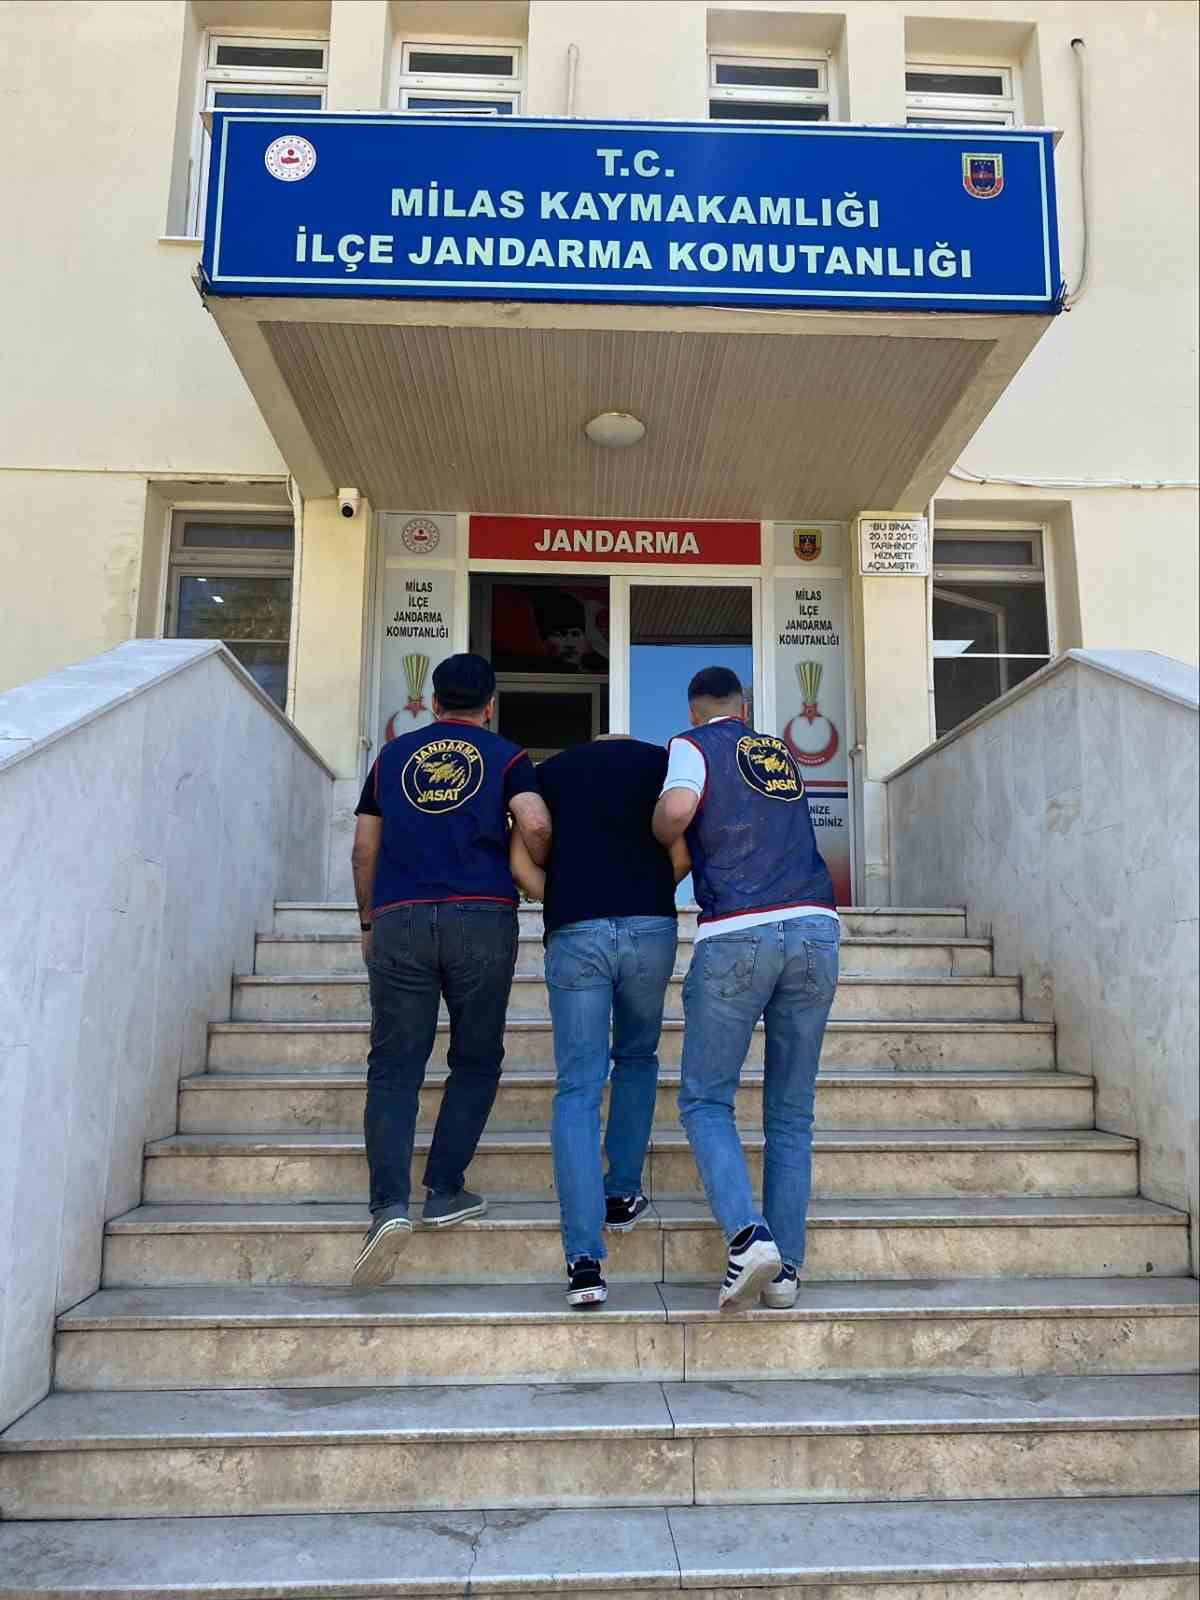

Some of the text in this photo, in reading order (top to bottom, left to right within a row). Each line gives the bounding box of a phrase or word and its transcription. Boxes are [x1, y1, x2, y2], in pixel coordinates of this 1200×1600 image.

[596, 148, 675, 177] T.C.
[391, 180, 879, 228] MİLAS KAYMAKAMLIĞI
[296, 225, 972, 278] İLÇE JANDARMA KOMUTANLIĞI
[534, 528, 700, 554] JANDARMA
[405, 579, 433, 592] MİLAS
[795, 587, 822, 601] MİLAS
[408, 595, 429, 610] İLÇE
[393, 611, 442, 623] JANDARMA
[799, 603, 820, 618] İLÇE
[386, 625, 449, 638] KOMUTANLIĞI
[785, 619, 833, 631] JANDARMA
[779, 632, 840, 646] KOMUTANLIĞI
[414, 741, 479, 764] JANDARMA
[765, 779, 798, 792] JASAT
[417, 788, 459, 803] JASAT
